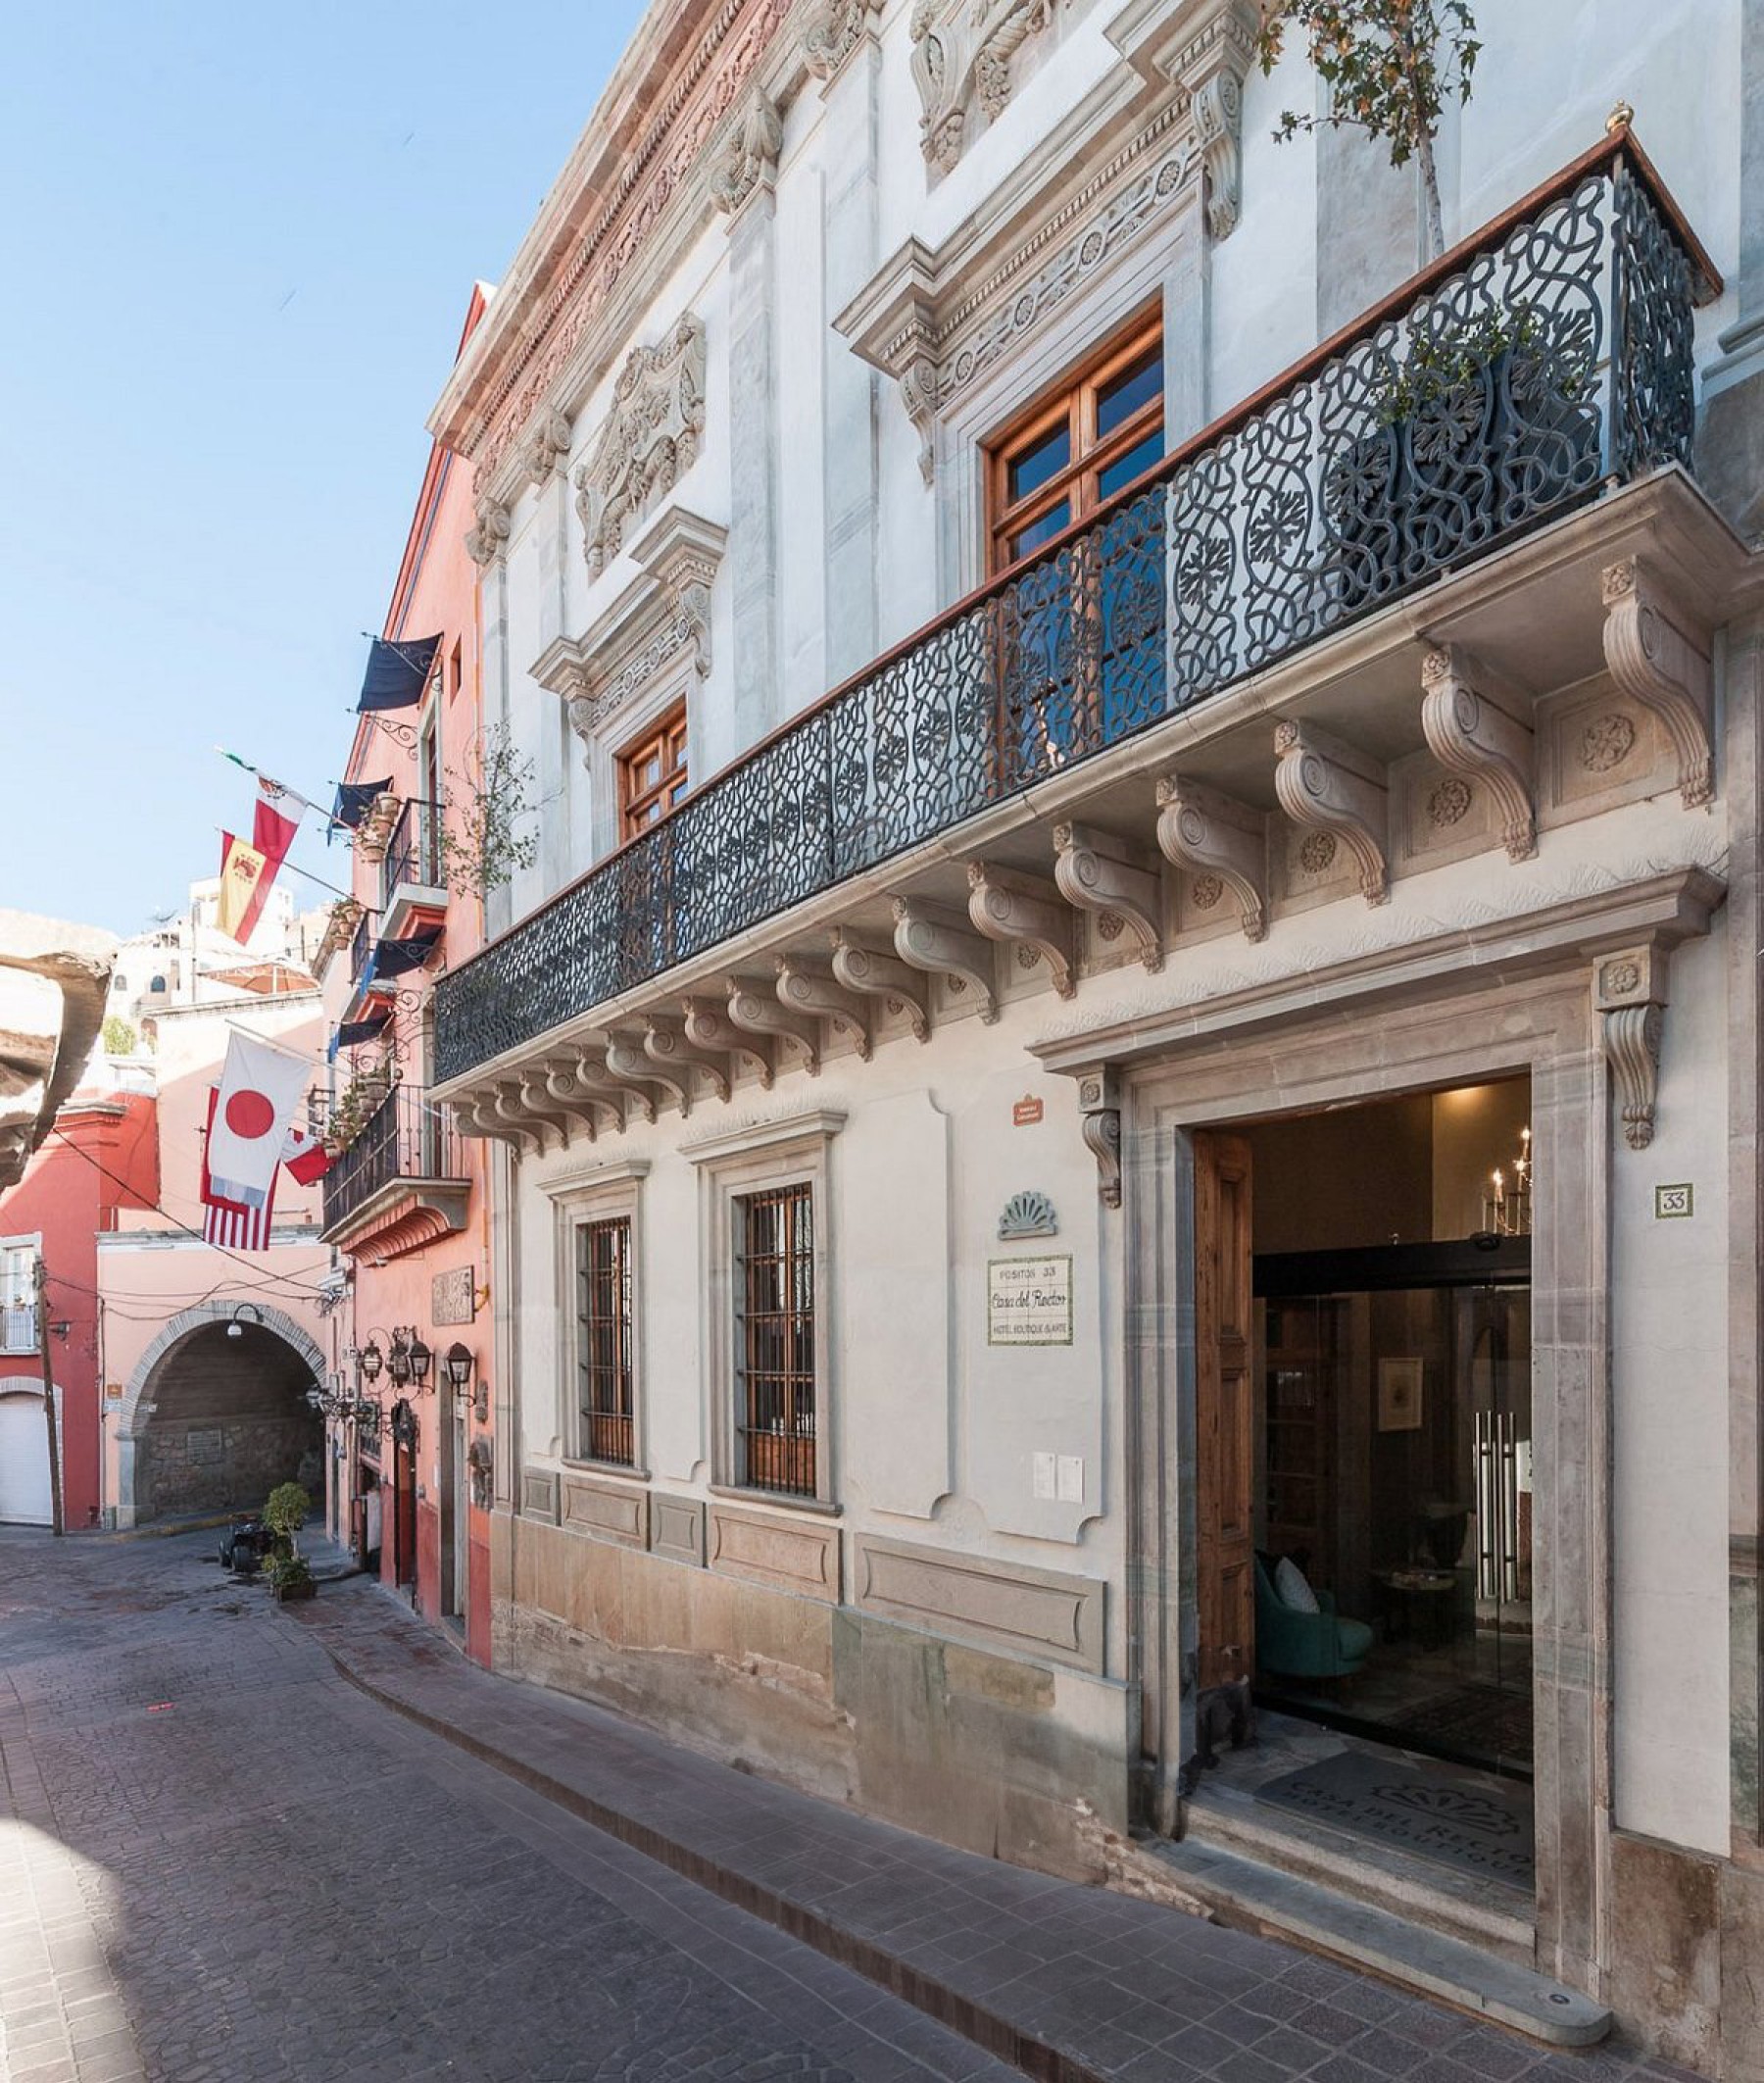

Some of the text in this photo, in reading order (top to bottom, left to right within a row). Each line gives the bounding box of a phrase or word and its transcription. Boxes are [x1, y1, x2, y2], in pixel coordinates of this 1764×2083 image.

[1663, 1191, 1686, 1210] 33
[1291, 1781, 1533, 1863] CASA DEL RECTO
